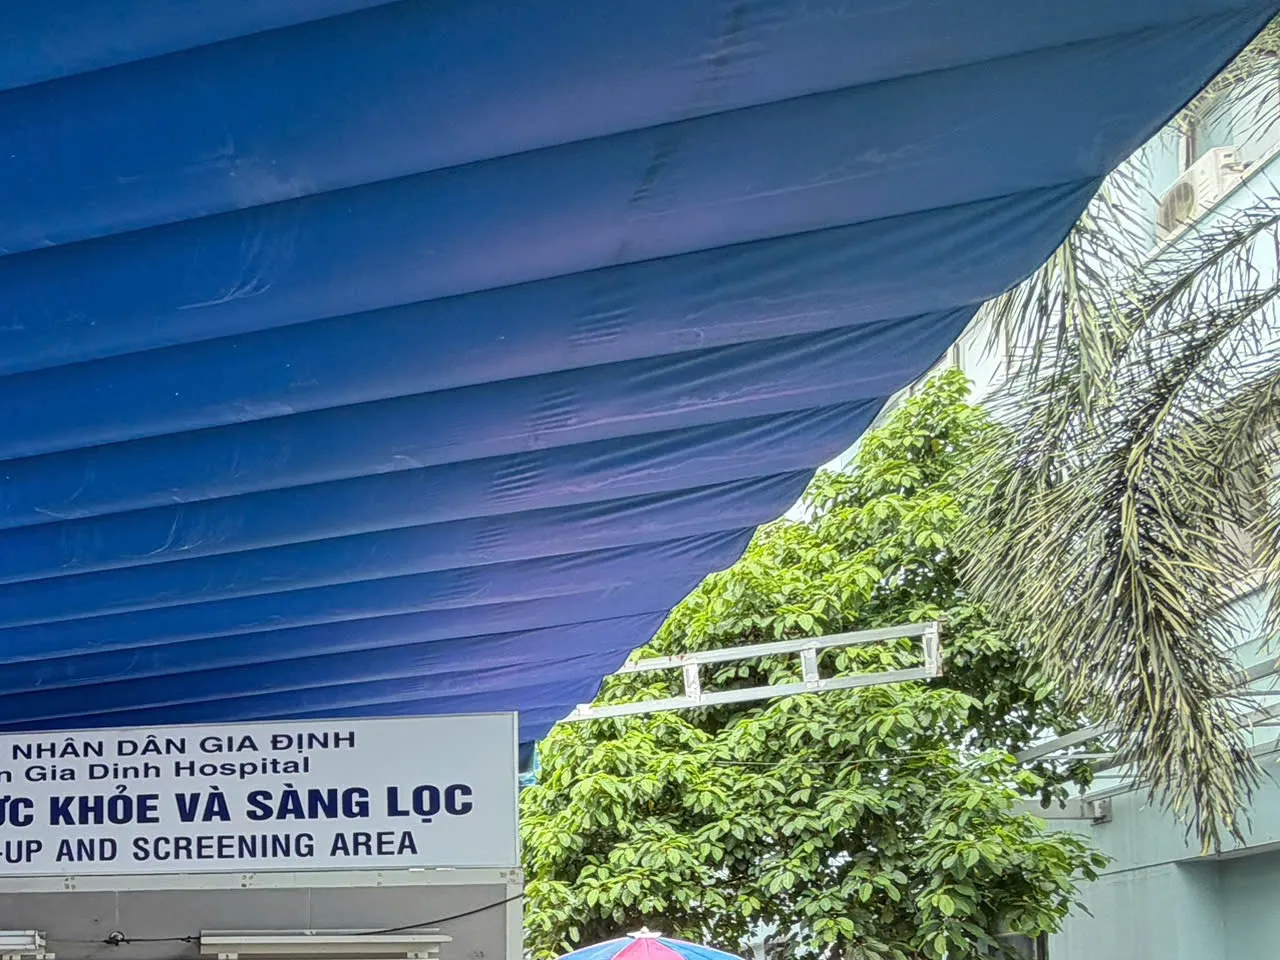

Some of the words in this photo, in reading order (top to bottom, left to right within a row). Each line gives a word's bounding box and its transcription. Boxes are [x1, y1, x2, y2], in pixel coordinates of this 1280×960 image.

[12, 737, 104, 761] NHÂN
[117, 734, 186, 757] DÂN
[199, 735, 259, 754] GIA
[270, 731, 355, 754] ĐỊNH
[24, 764, 76, 782] Gia
[88, 762, 161, 780] Dinh
[174, 756, 309, 780] Hospital
[49, 784, 160, 826] KHỎE
[174, 785, 231, 823] VÀ
[246, 782, 370, 821] SÀNG
[386, 783, 473, 824] LỌC
[55, 838, 117, 862] AND
[132, 832, 314, 861] SCREENING
[329, 830, 418, 857] AREA
